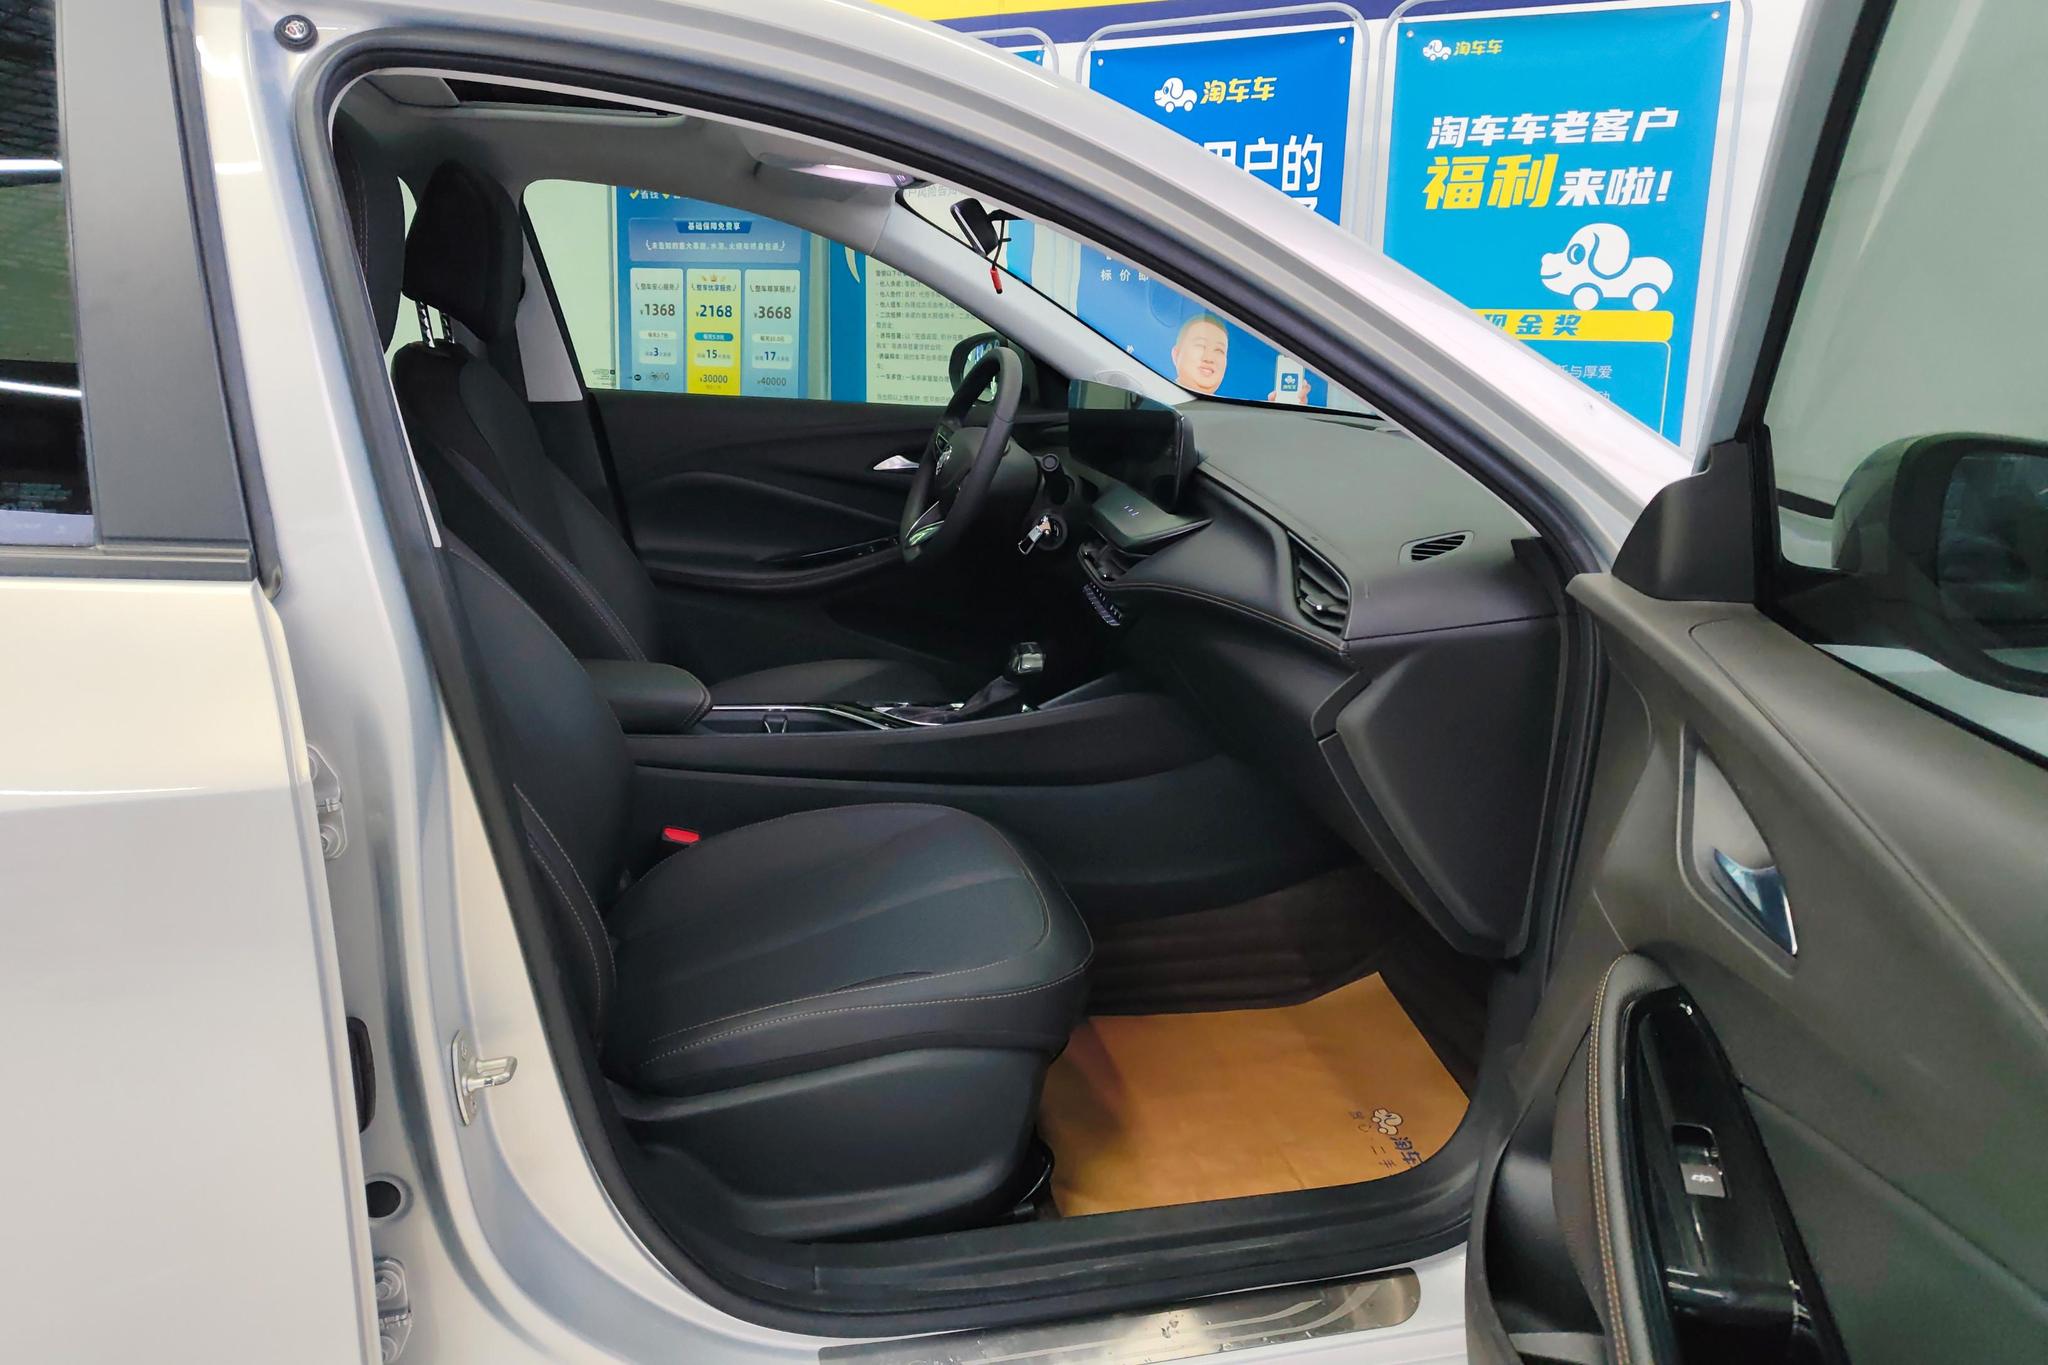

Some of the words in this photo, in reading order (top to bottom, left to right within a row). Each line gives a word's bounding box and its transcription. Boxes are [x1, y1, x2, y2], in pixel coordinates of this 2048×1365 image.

[1453, 38, 1504, 57] 淘车车
[1200, 76, 1278, 104] 淘车车
[1426, 106, 1679, 150] 淘车车老客户
